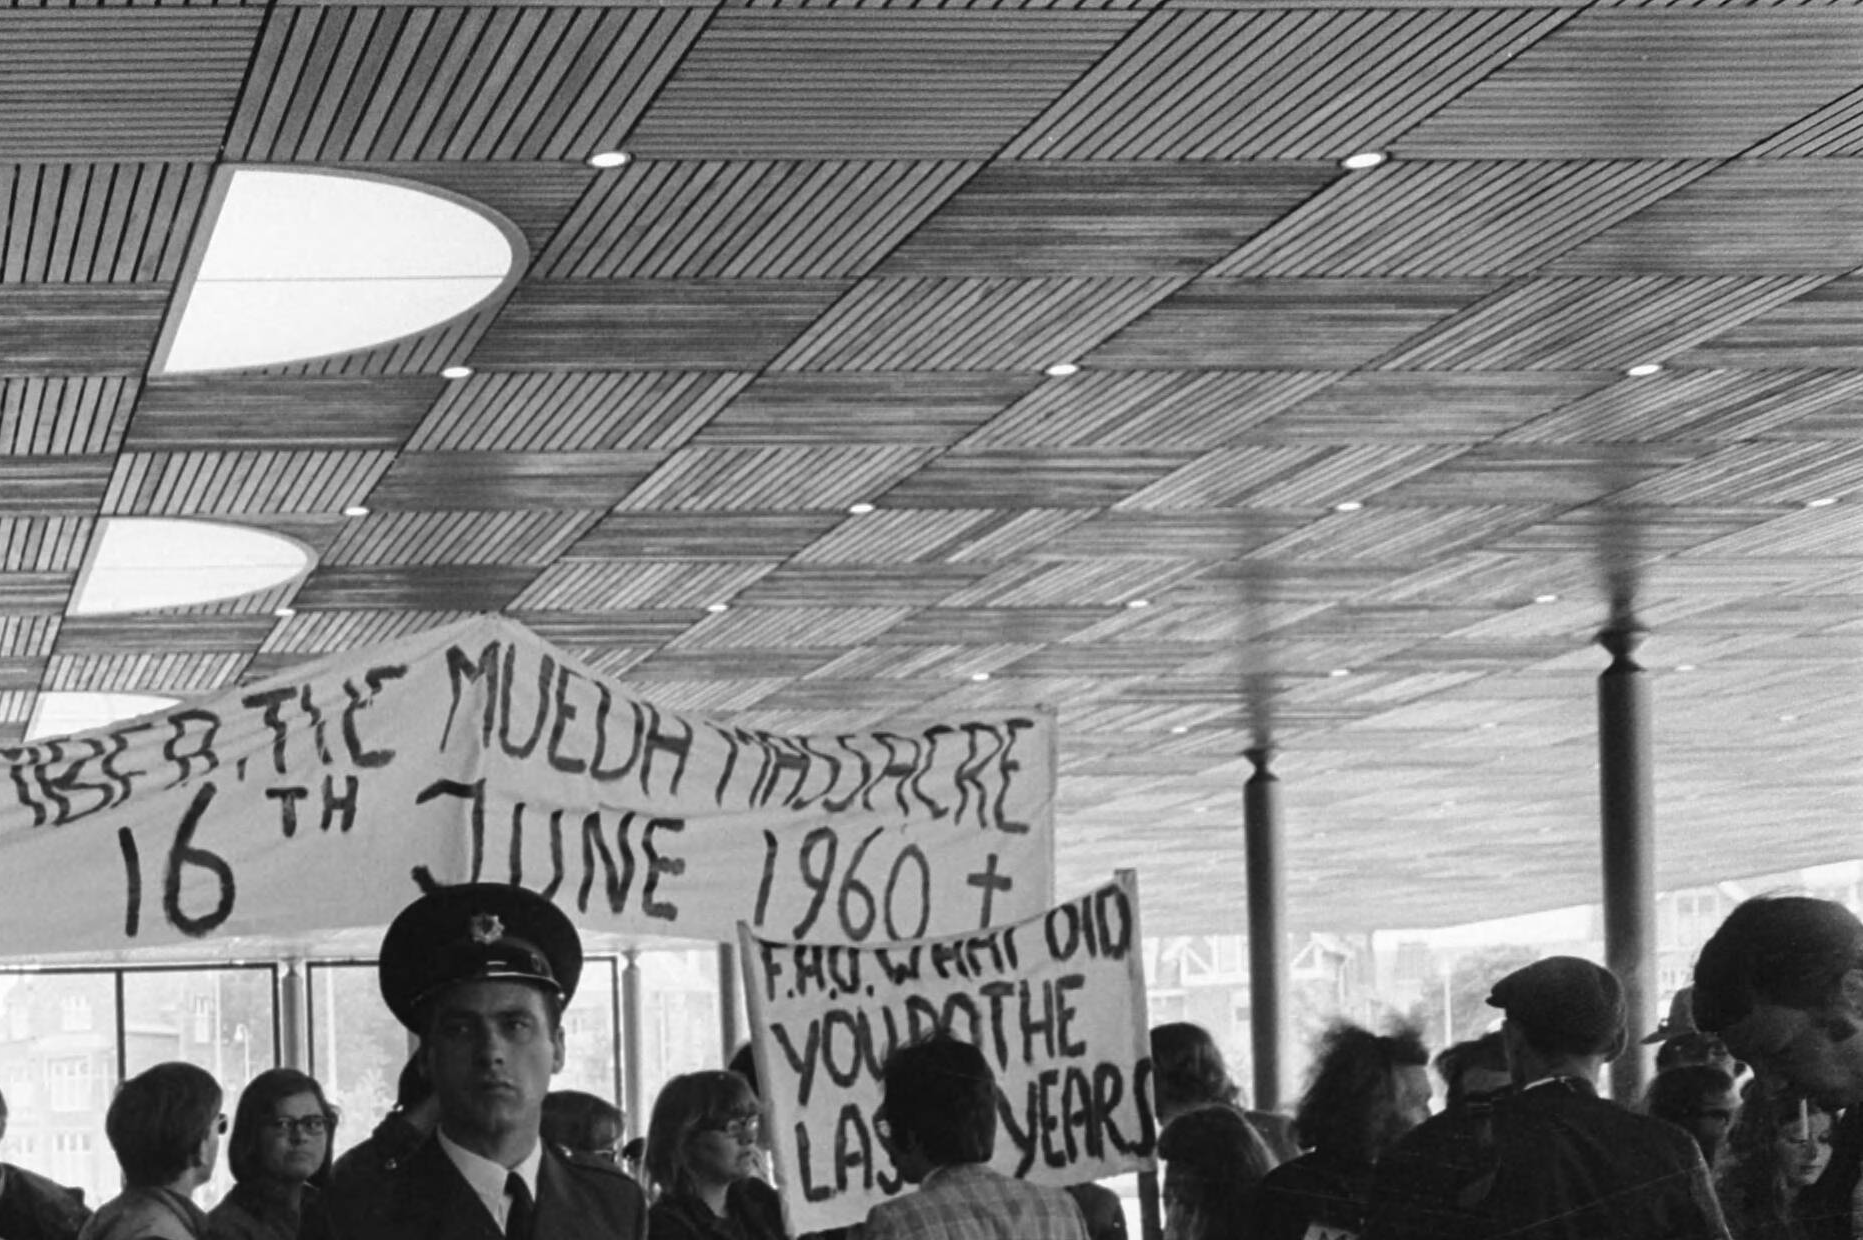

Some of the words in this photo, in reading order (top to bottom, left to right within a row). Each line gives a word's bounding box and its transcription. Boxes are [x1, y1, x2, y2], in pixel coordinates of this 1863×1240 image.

[411, 779, 686, 921] JUNE
[753, 825, 930, 942] 1960
[980, 974, 1087, 1070] THE
